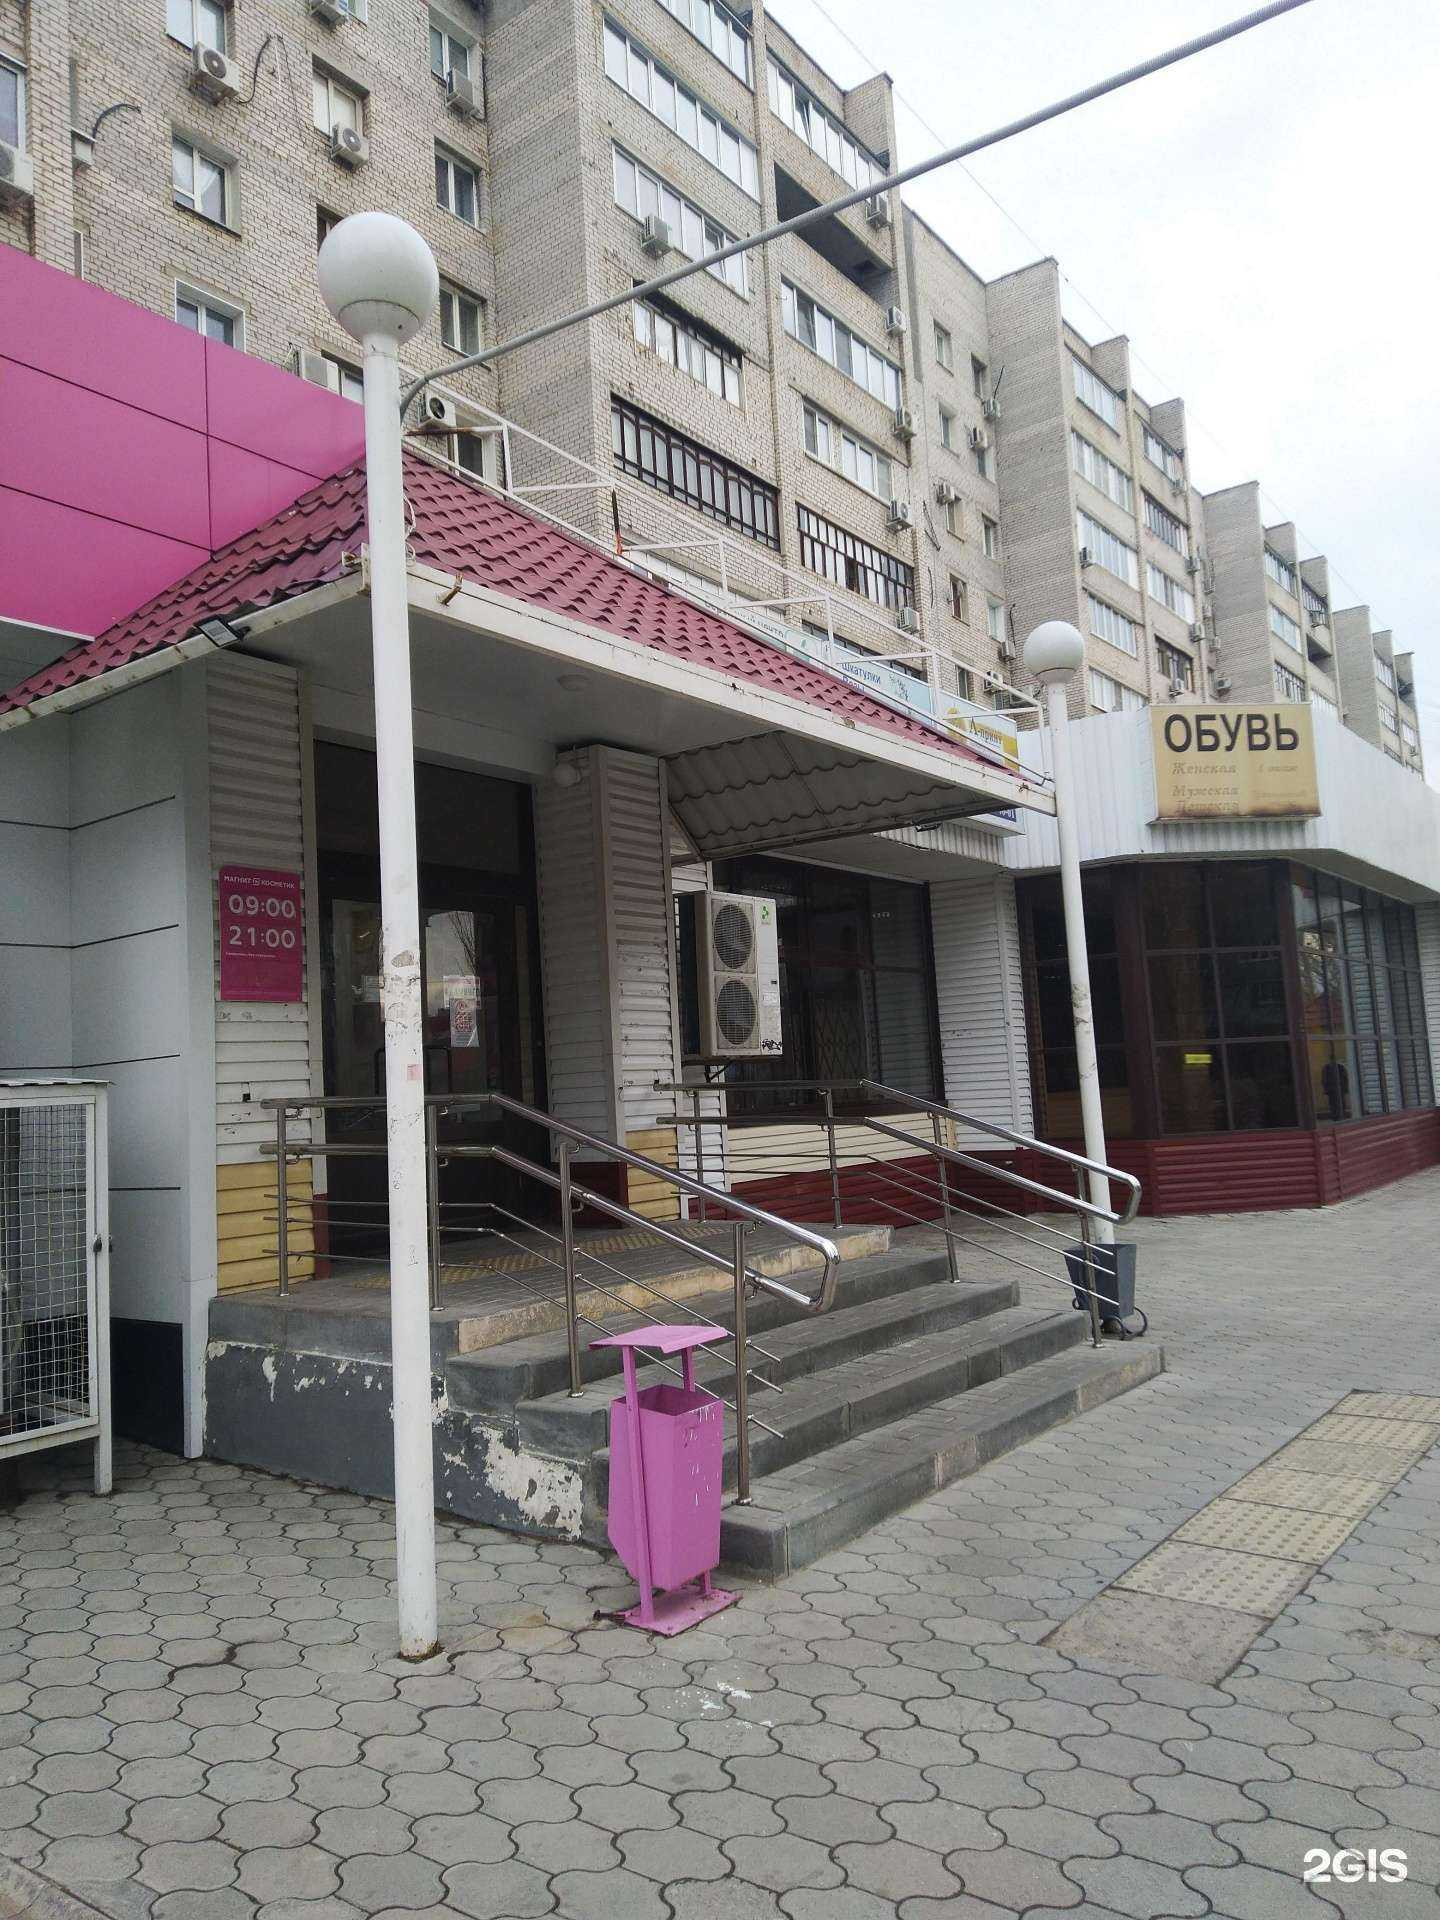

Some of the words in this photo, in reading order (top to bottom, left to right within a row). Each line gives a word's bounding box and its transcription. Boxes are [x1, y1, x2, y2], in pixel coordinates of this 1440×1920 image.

[1164, 713, 1300, 753] ОБУВЬ
[1172, 760, 1237, 775] Женская
[1171, 785, 1239, 799] Мужская
[224, 875, 251, 884] МАГНИТ
[261, 880, 295, 889] КОСМЕТИК
[228, 894, 296, 918] 09:00
[228, 925, 296, 949] 21:00
